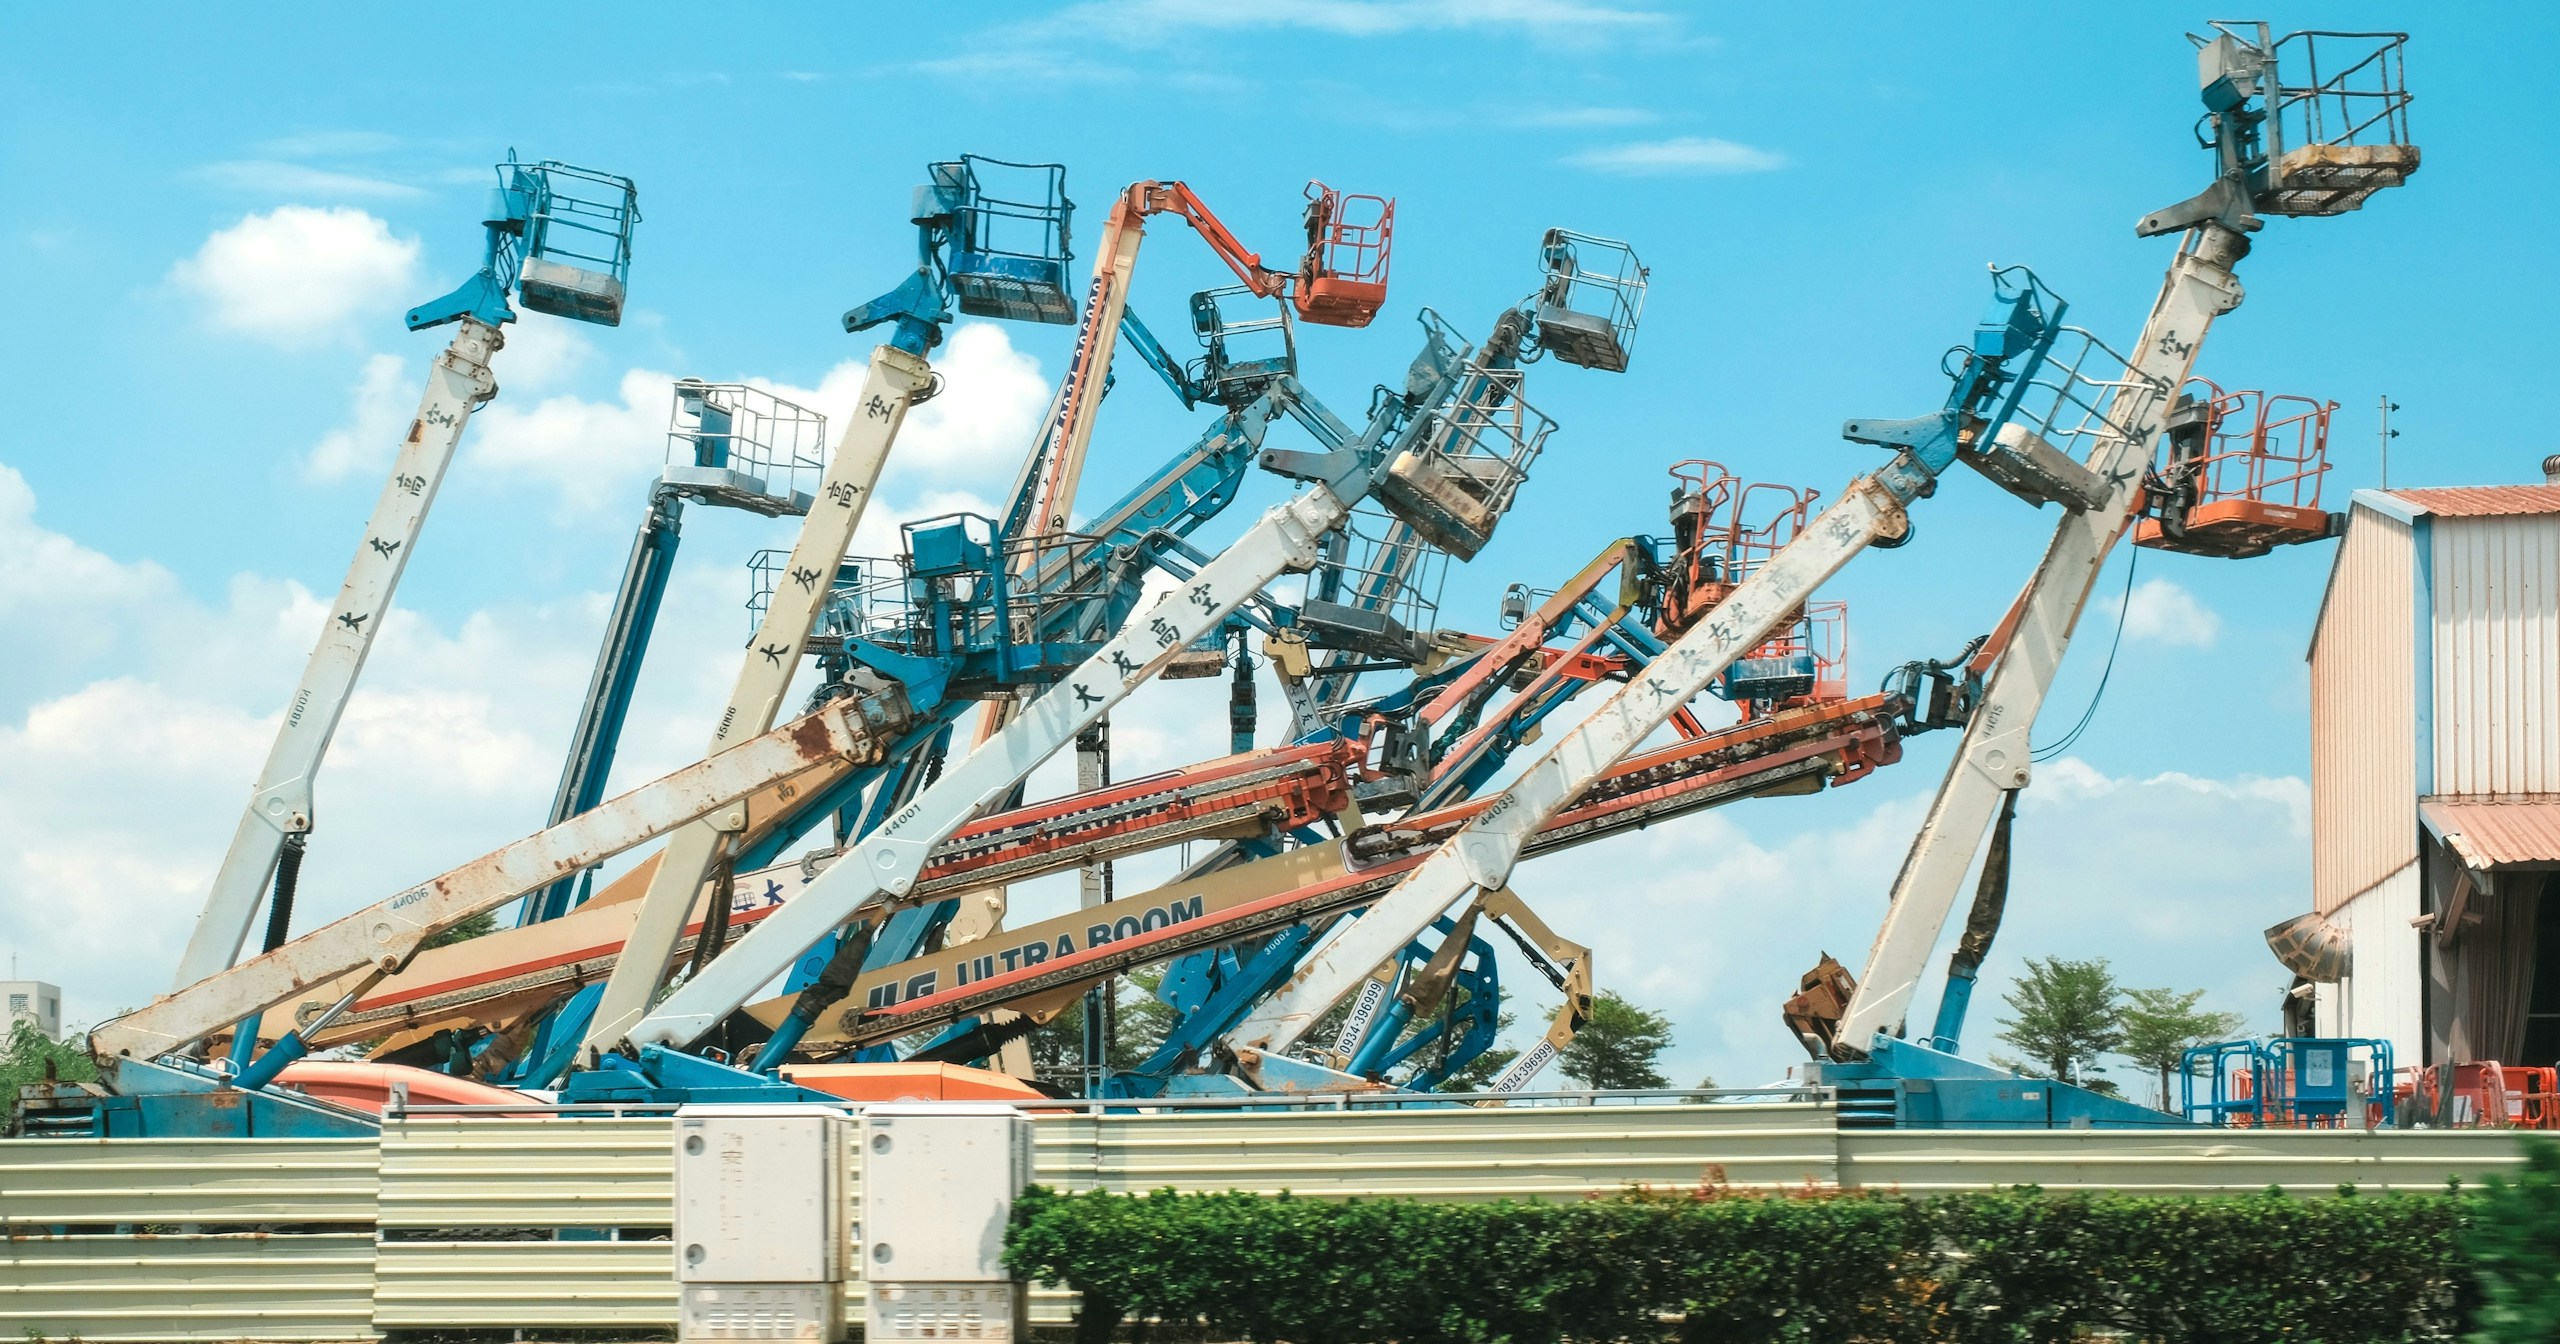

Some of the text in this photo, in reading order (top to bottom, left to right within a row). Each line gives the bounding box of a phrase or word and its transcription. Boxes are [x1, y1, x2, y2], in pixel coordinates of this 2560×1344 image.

[759, 394, 895, 669] 大友高空
[1072, 582, 1220, 711] 大友高空
[716, 706, 737, 741] 45006
[884, 803, 922, 838] 44001
[392, 887, 429, 910] 44006
[1086, 893, 1205, 949] BOOM
[1263, 928, 1291, 956] 30002
[1339, 980, 1383, 1055] 0934-396999
